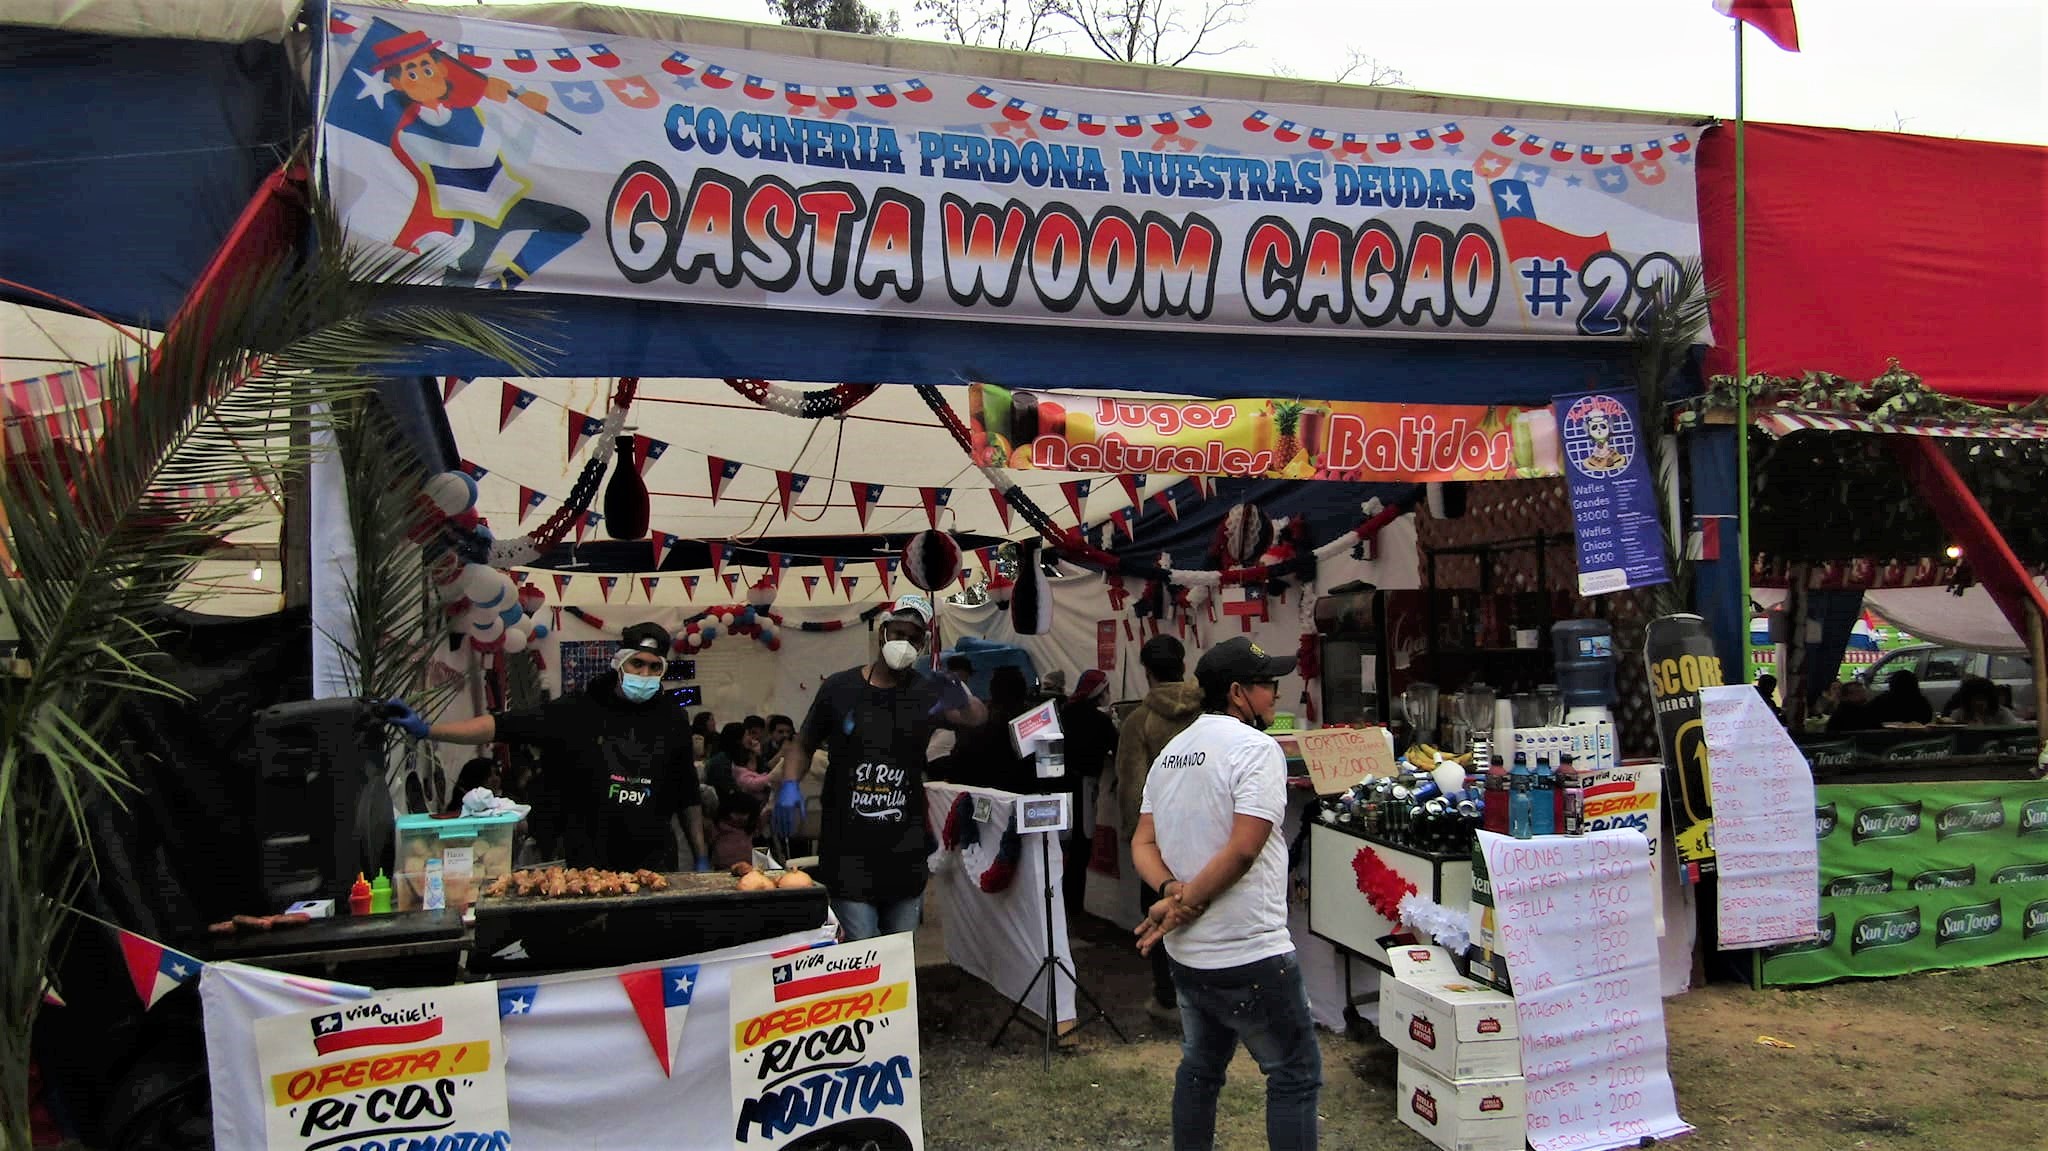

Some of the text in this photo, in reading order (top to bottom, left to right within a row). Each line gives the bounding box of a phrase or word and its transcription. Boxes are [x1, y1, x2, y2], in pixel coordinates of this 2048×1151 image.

[664, 104, 1476, 211] COCINERIA PERDONA NUESTRAS DEUDAS
[606, 161, 1501, 328] GASTA WOOM CAGAO
[1523, 250, 1686, 337] #22
[1095, 397, 1236, 438] Jugos
[1032, 433, 1274, 475] Naturales
[1327, 415, 1512, 475] Batidos
[1573, 484, 1605, 496] Wafles
[1573, 496, 1610, 510] Grandes
[1576, 509, 1609, 522] $3000
[1580, 526, 1612, 539] Wafles
[1583, 541, 1613, 552] Chicos
[1585, 552, 1614, 565] $1500
[1651, 654, 1725, 698] SCORE
[1304, 732, 1365, 751] CORTITOS
[1160, 751, 1206, 769] ARMANDO
[1312, 759, 1326, 780] 4
[1339, 756, 1379, 777] 2000
[856, 763, 905, 787] El Rey
[608, 783, 647, 806] Fpay
[851, 789, 906, 809] parrilla
[1584, 793, 1650, 817] FERTA!
[1857, 814, 1881, 835] San
[1881, 811, 1918, 833] Jorge
[1938, 808, 2002, 831] San Jorge
[1491, 839, 1563, 876] CORONAS
[1590, 860, 1633, 887] 1500
[1508, 897, 1556, 920] STELLA
[1589, 886, 1630, 910] 1500
[1589, 910, 1630, 933] 1500
[1855, 924, 1881, 945] San
[1881, 920, 1918, 942] Jorge
[1940, 913, 2000, 937] San Jorge
[1591, 931, 1629, 955] 1500
[1518, 999, 1574, 1021] PATAGONIA
[1594, 978, 1630, 1004] 2000
[743, 987, 892, 1046] OFERTA!
[1606, 1035, 1645, 1063] 1500
[1525, 1081, 1579, 1105] MONSTER
[1606, 1065, 1645, 1088] 2000
[735, 1055, 913, 1143] MOJITOS
[1527, 1113, 1550, 1130] RED
[1609, 1091, 1642, 1114] 2000
